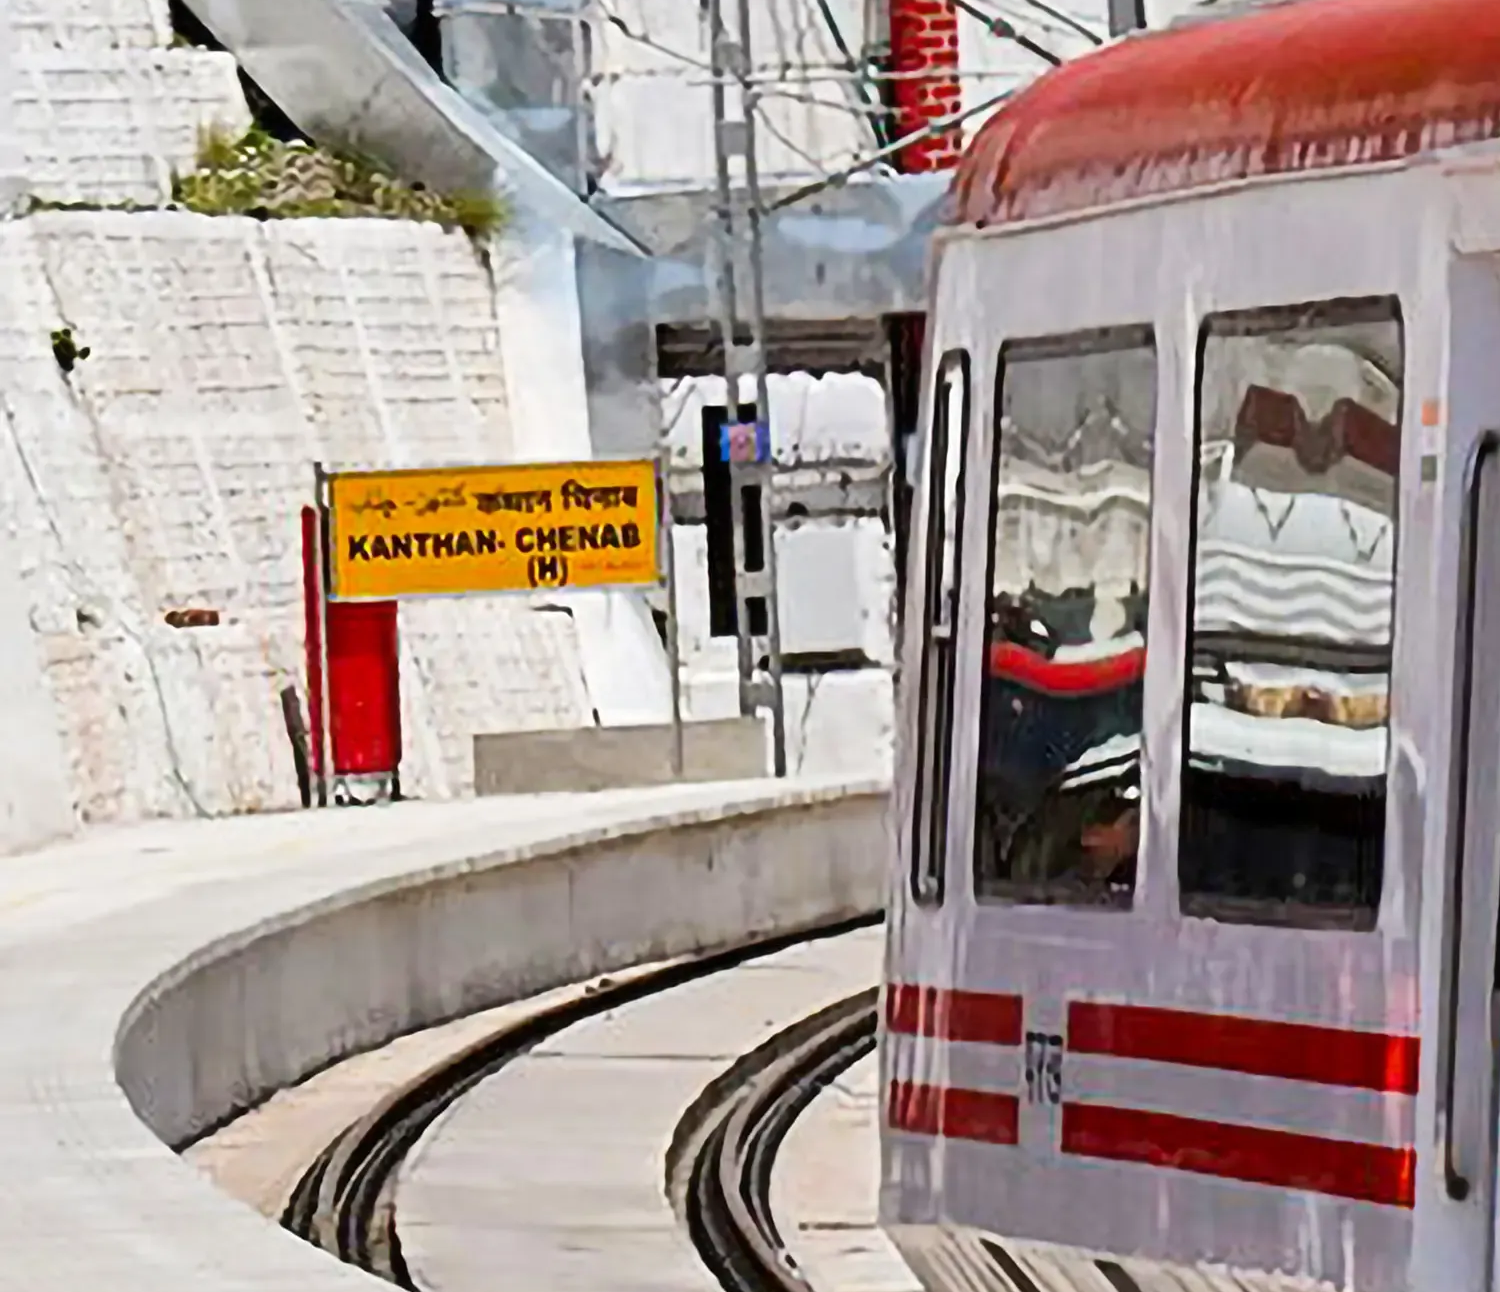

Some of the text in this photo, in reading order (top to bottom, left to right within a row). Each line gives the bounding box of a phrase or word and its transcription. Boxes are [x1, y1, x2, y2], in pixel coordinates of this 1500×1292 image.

[348, 522, 641, 562] KANTHAN- CHENAB
[526, 553, 569, 589] (H)
